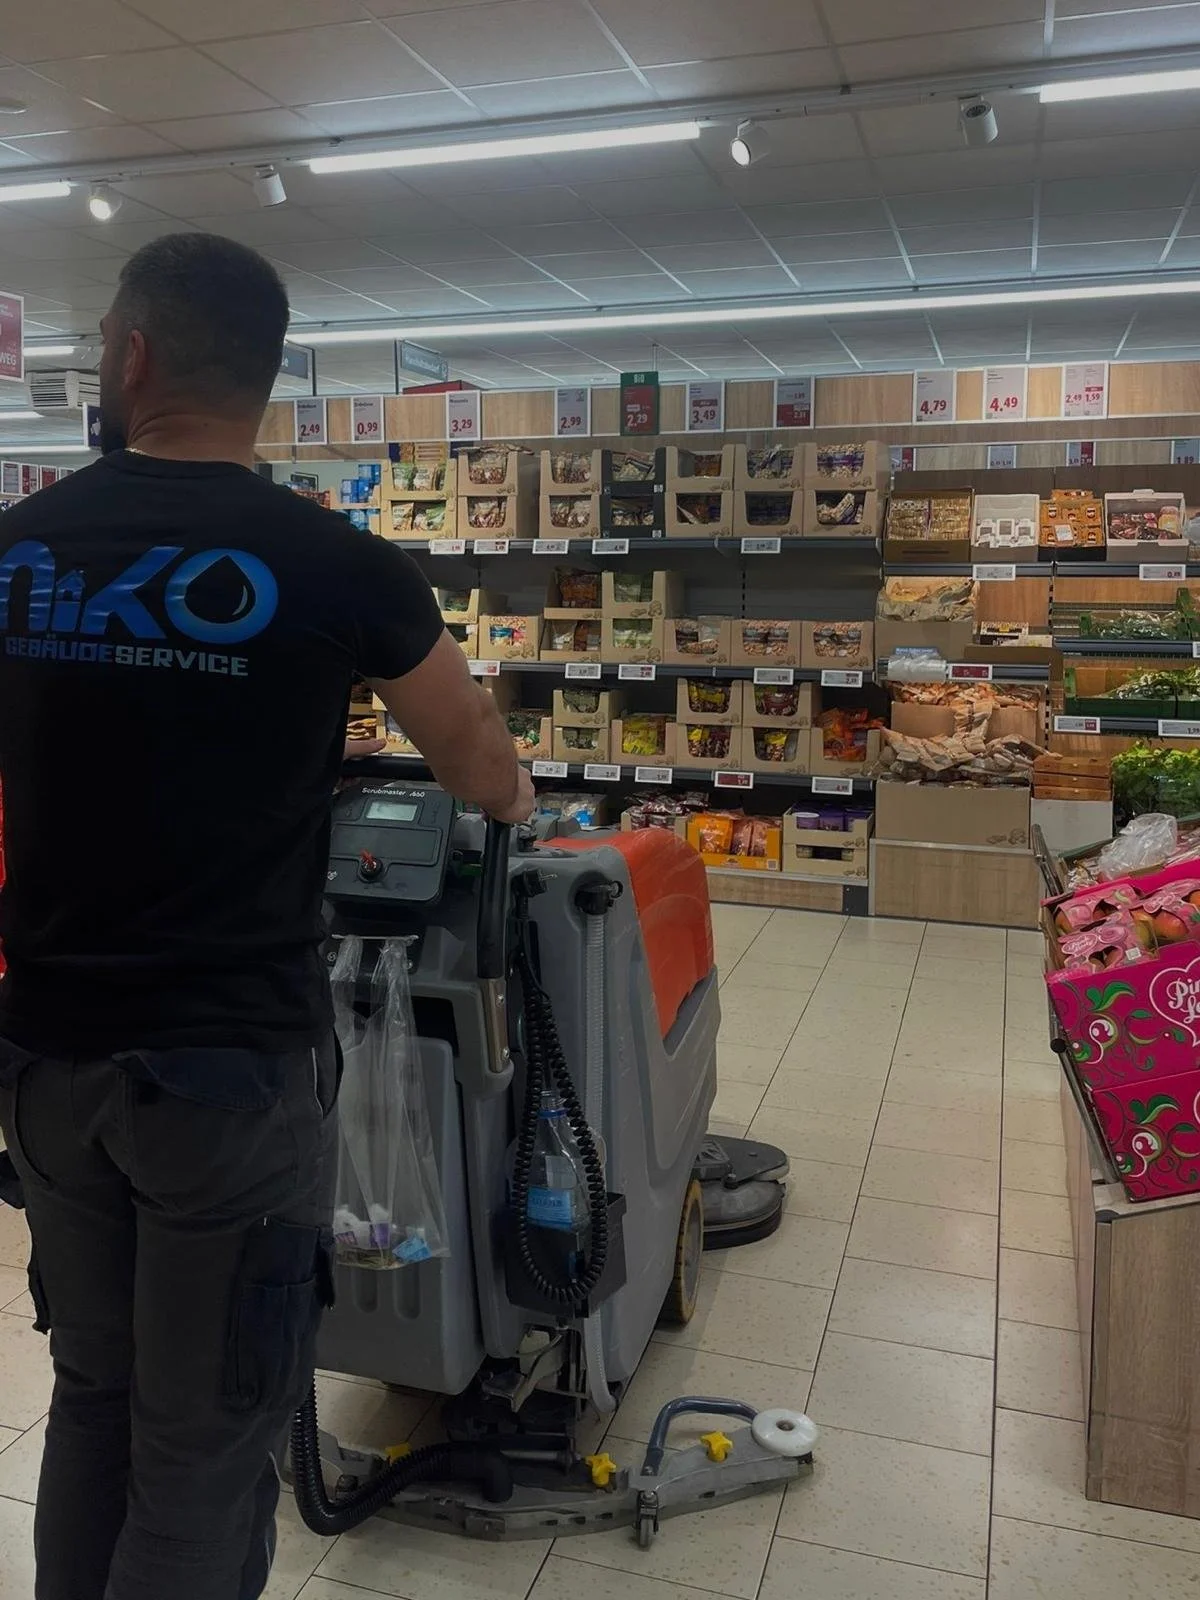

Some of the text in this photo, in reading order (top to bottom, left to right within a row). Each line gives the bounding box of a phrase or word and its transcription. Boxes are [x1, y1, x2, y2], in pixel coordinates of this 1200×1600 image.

[920, 399, 947, 415] 4.79
[990, 396, 1018, 412] 4.49
[560, 416, 582, 429] 2.99
[627, 413, 648, 428] 2.29
[692, 410, 716, 424] 3.49
[300, 423, 320, 437] 2.49
[357, 421, 378, 435] 0.99
[451, 418, 472, 433] 3.29
